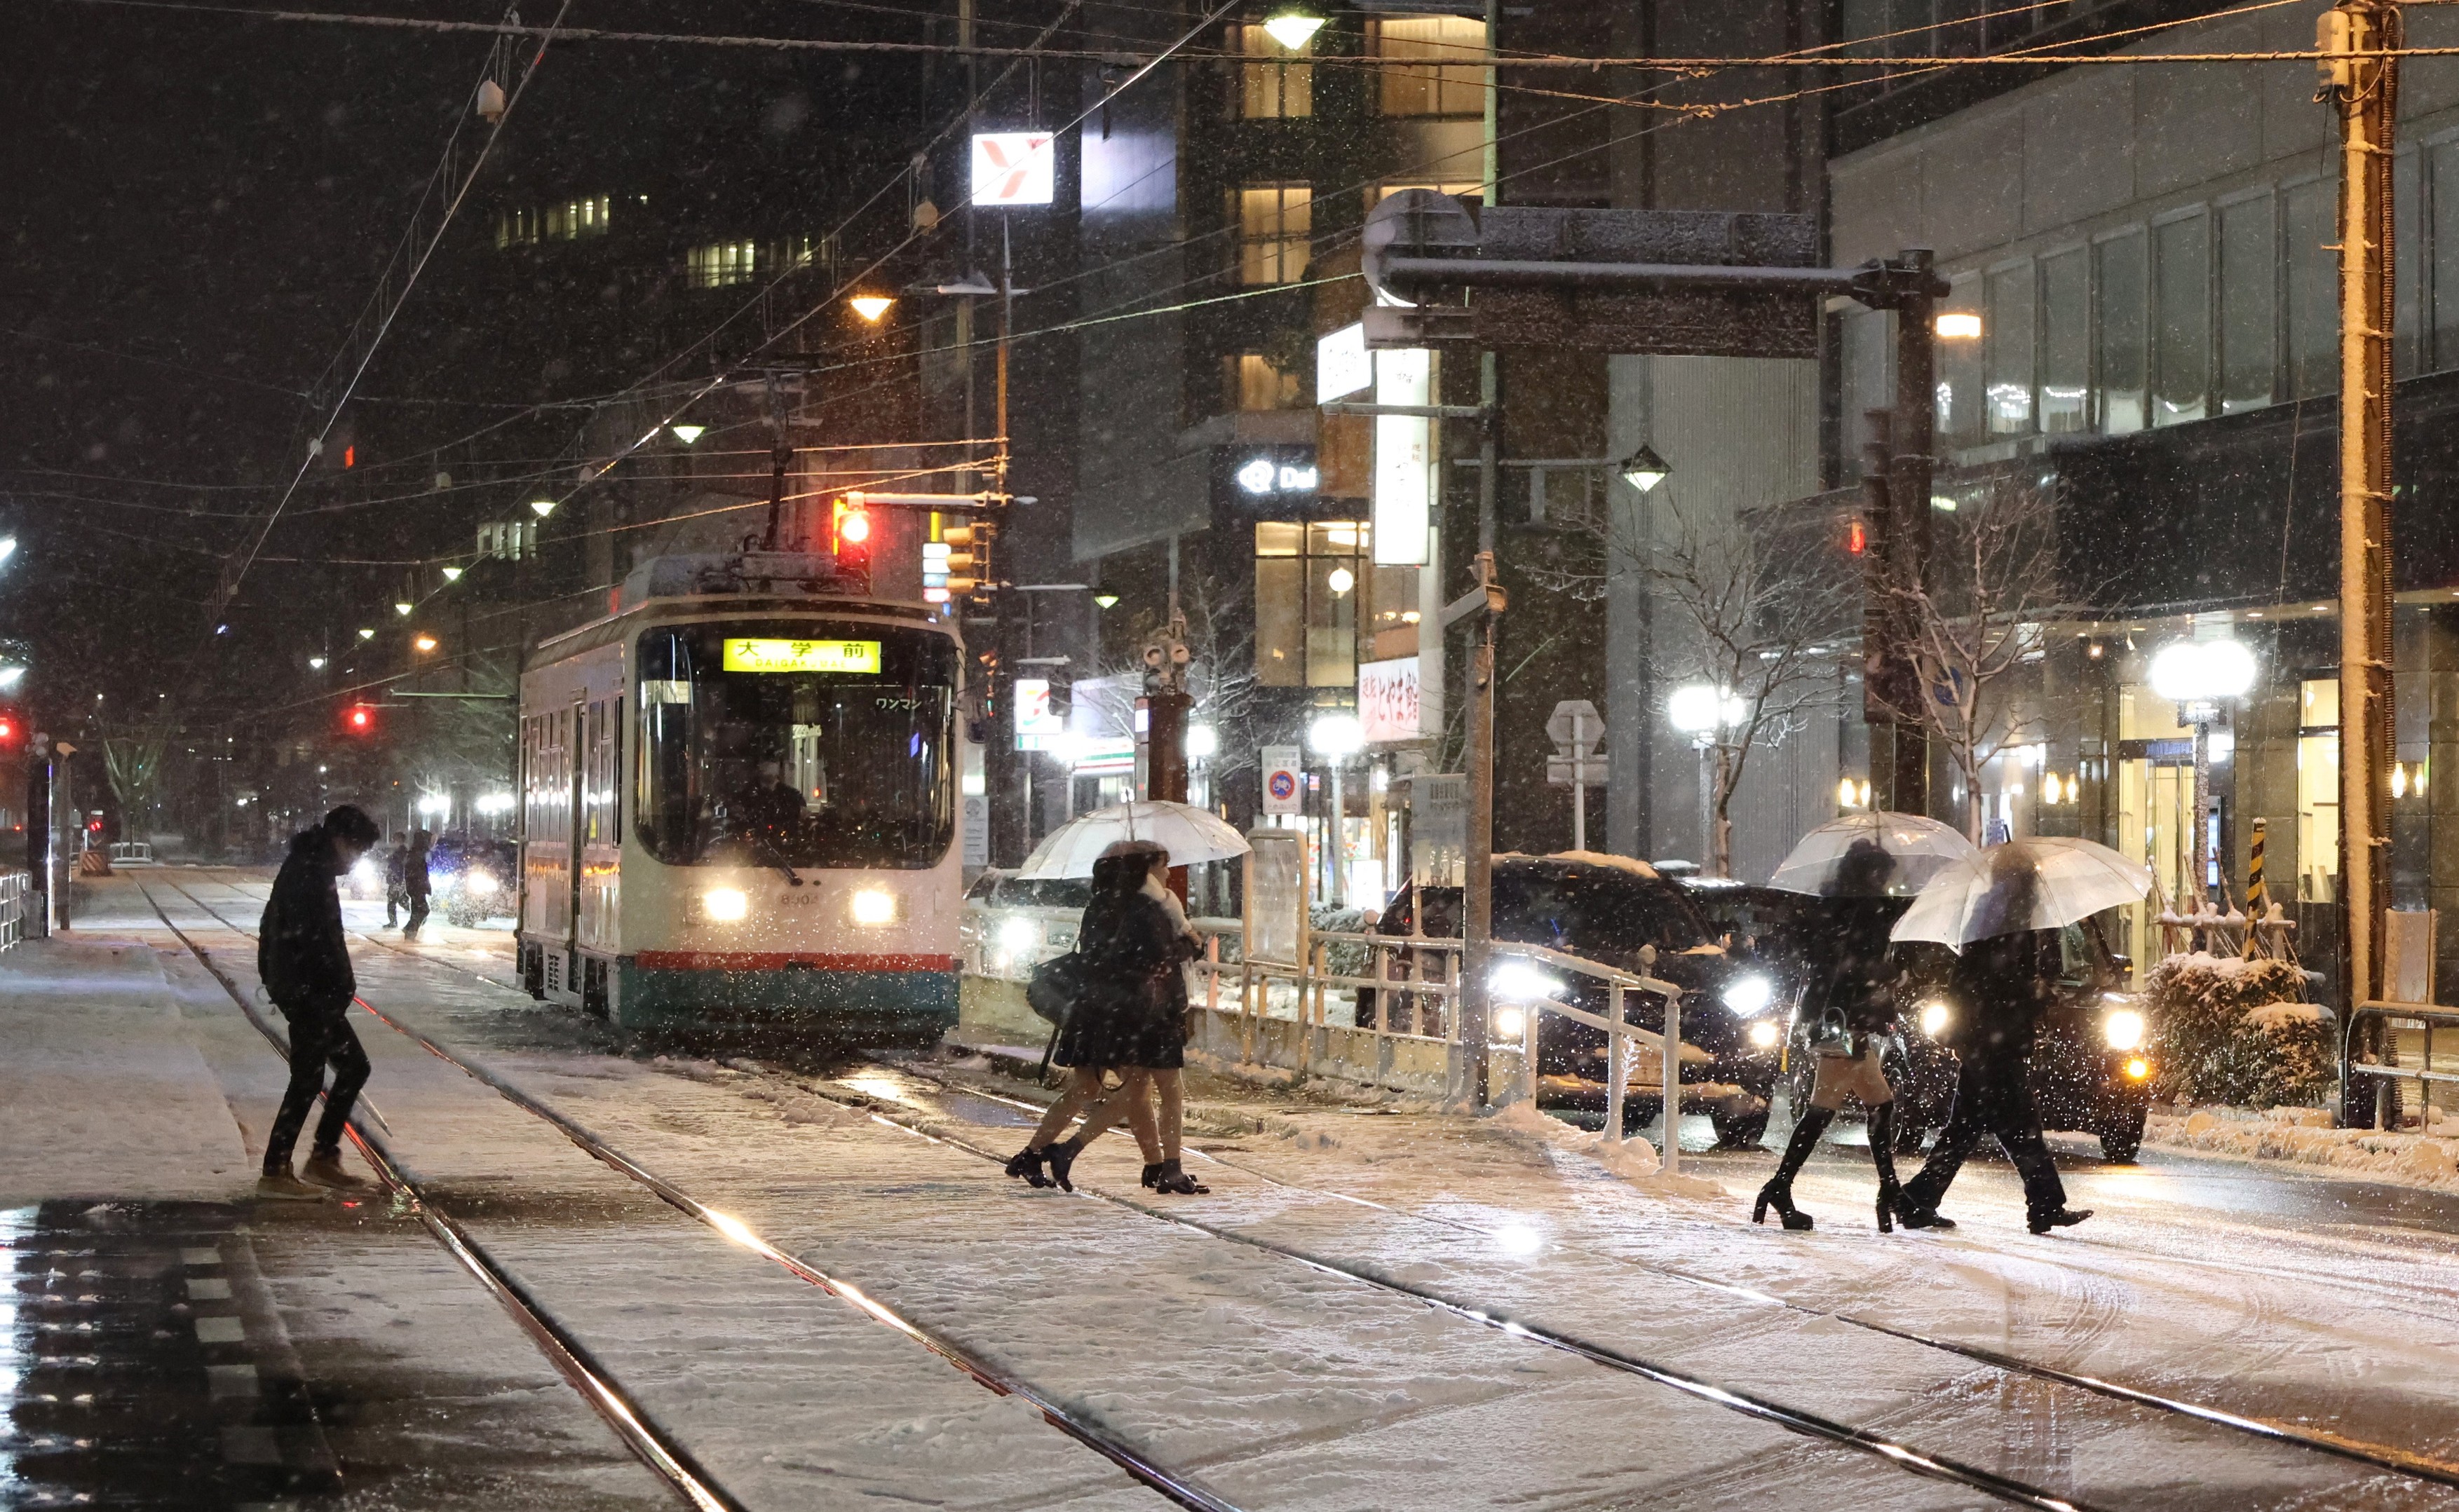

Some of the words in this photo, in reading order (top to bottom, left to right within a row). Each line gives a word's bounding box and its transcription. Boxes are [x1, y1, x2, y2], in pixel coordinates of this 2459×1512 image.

[737, 641, 865, 658] 大学前
[876, 697, 922, 710] ワンマン
